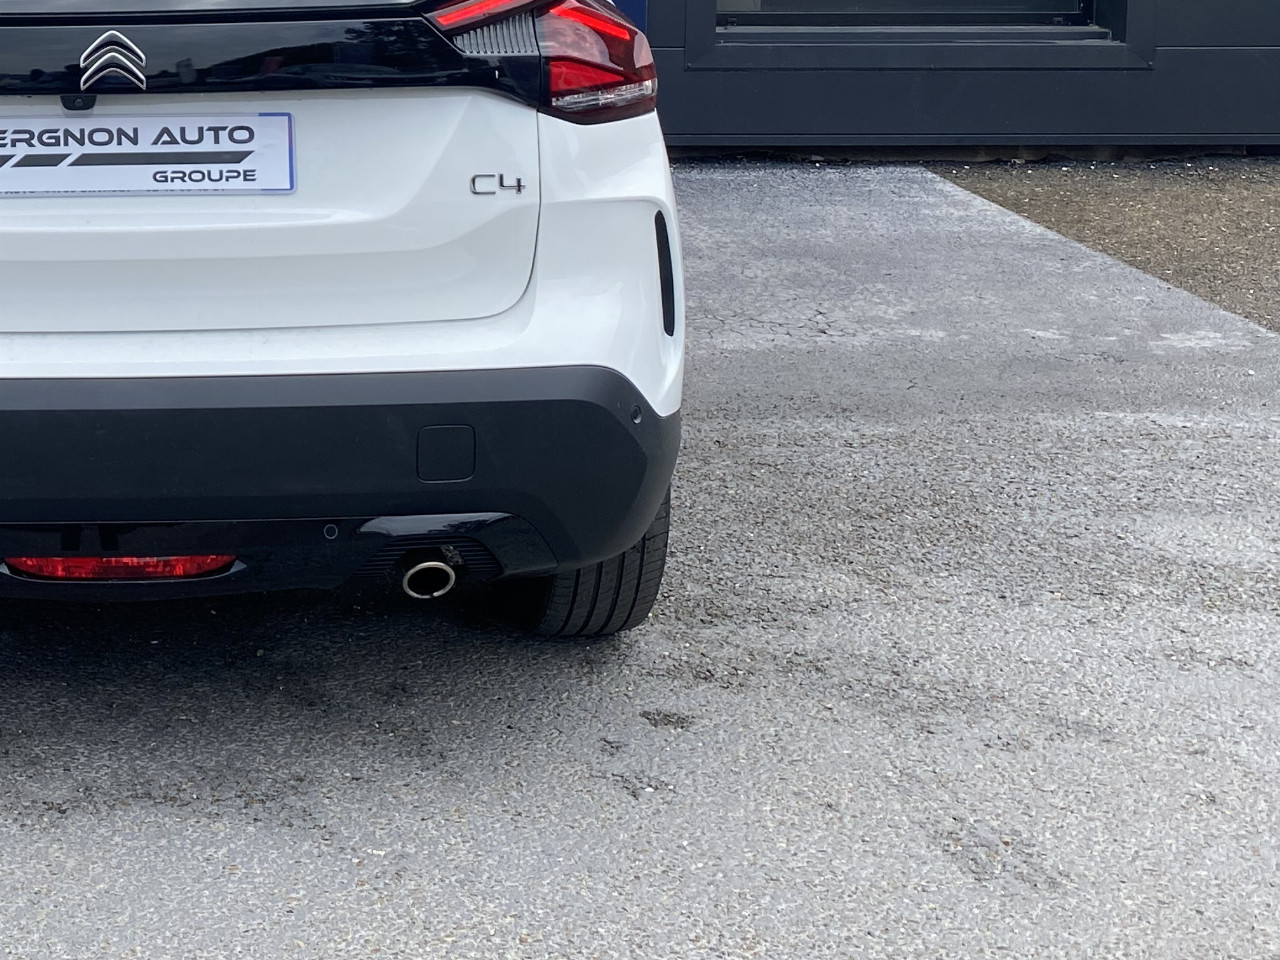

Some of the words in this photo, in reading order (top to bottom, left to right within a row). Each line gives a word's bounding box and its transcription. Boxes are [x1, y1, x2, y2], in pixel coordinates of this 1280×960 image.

[151, 125, 255, 146] AUTO
[152, 169, 257, 183] GROUPE
[470, 173, 526, 195] C4
